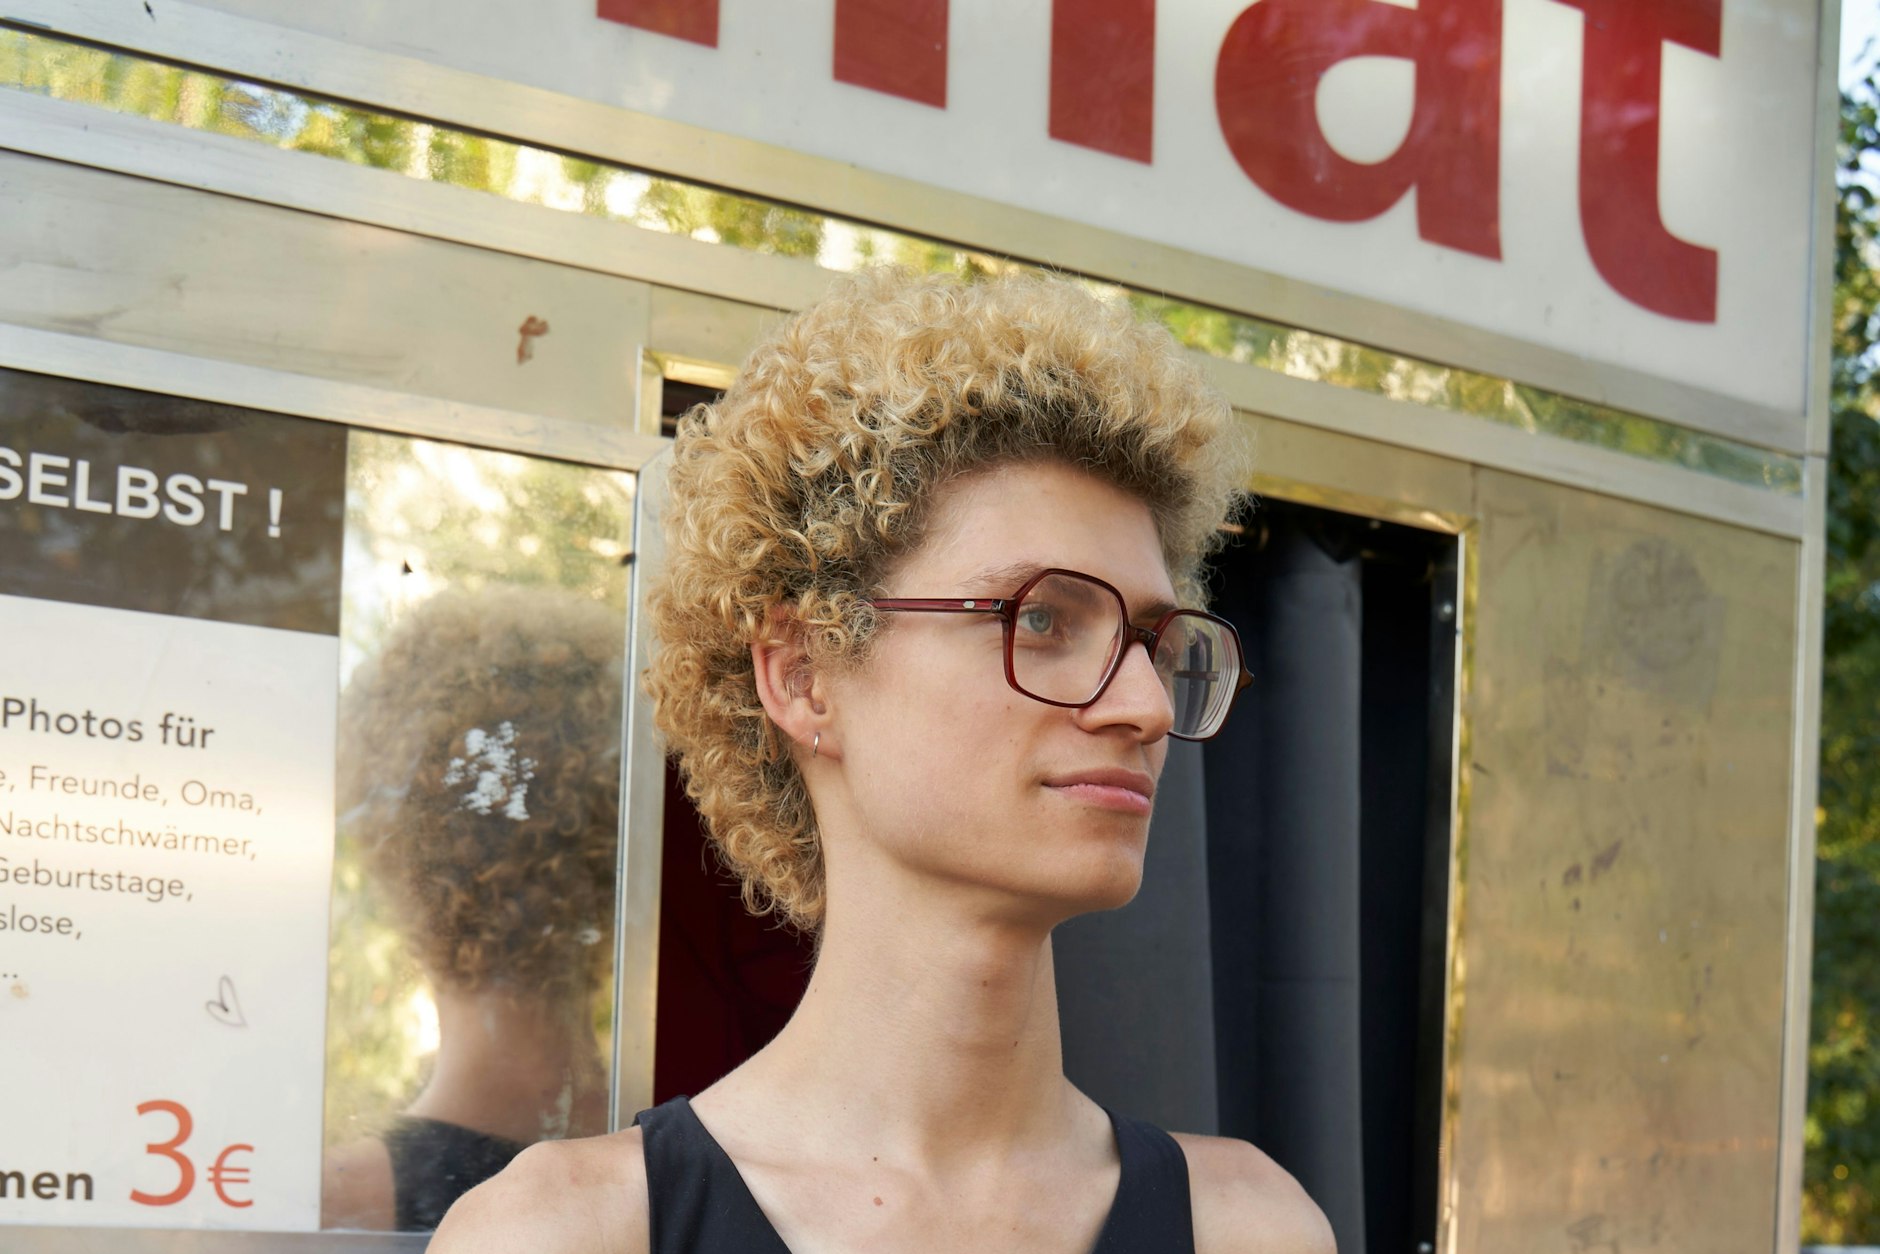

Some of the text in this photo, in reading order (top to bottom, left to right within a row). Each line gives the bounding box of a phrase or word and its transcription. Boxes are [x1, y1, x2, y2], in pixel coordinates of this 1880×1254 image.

[597, 0, 1722, 325] at
[0, 446, 248, 532] SELBST
[2, 697, 215, 749] Photos für
[30, 765, 168, 807] Freunde,
[181, 780, 263, 816] Oma,
